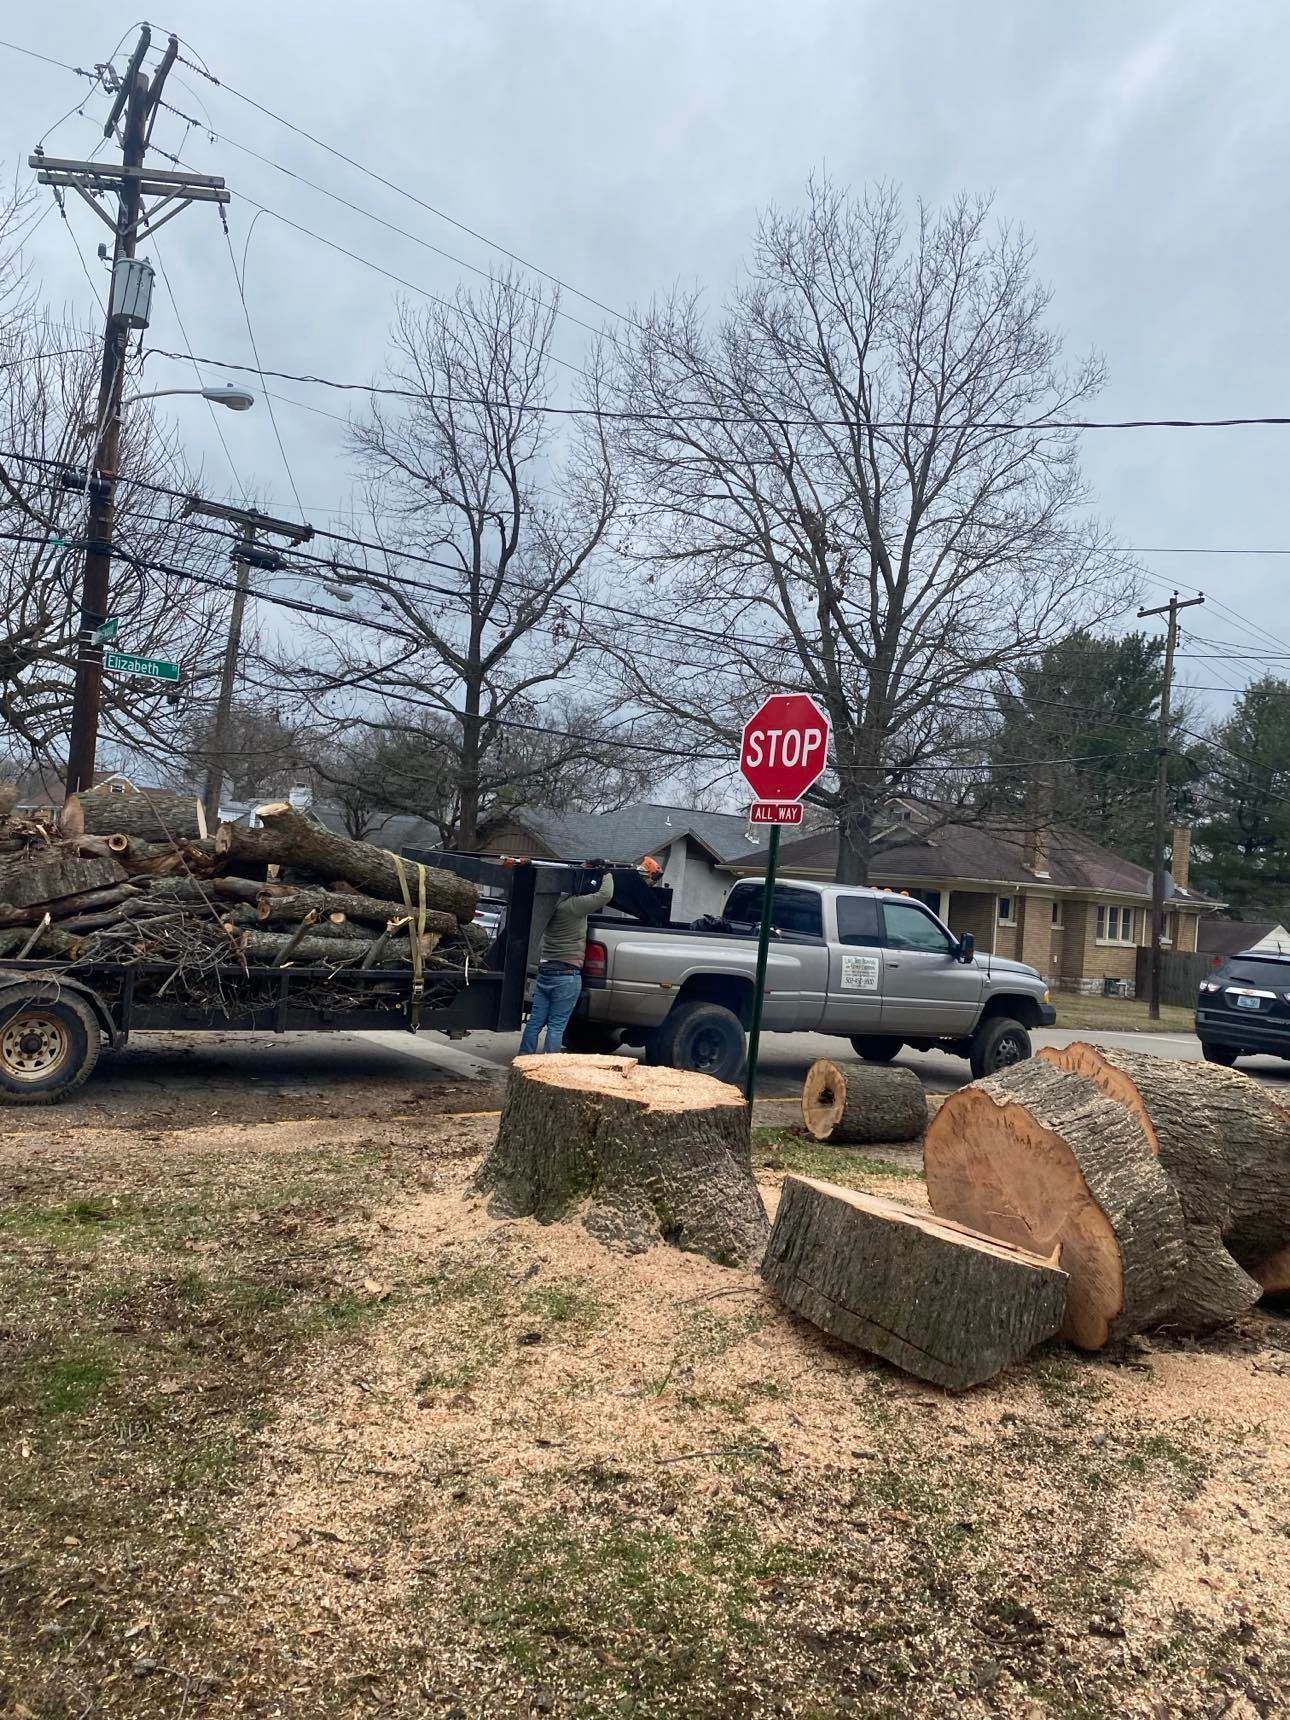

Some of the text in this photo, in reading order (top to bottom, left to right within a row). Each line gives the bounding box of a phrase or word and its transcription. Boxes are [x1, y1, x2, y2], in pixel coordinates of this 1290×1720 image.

[107, 654, 159, 676] Elizabeth
[746, 728, 822, 768] STOP
[755, 807, 798, 820] ALL WAY
